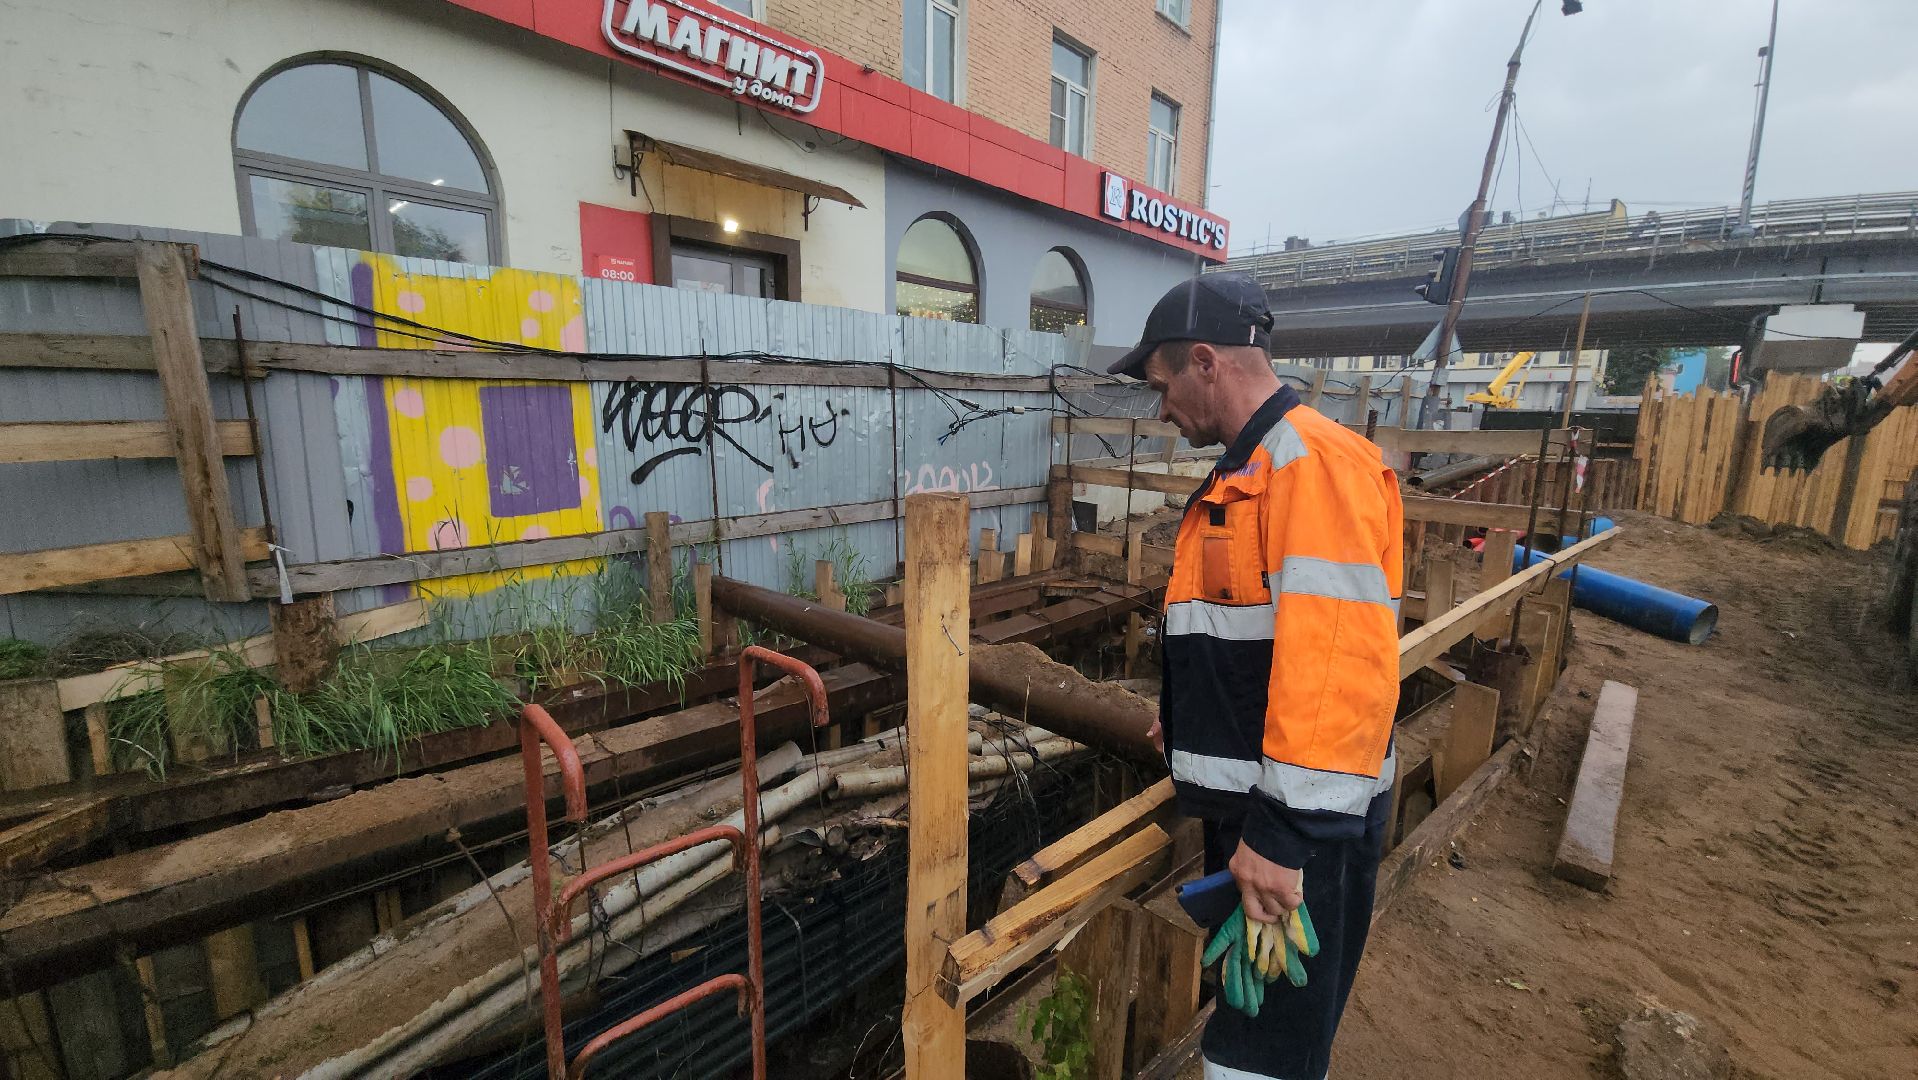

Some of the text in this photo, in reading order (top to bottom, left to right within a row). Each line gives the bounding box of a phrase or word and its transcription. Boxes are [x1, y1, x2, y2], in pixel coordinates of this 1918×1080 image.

[619, 0, 813, 95] МАГНИТ
[732, 76, 794, 107] у дома
[1131, 189, 1226, 250] ROSTIC'S
[602, 269, 634, 281] 08:00
